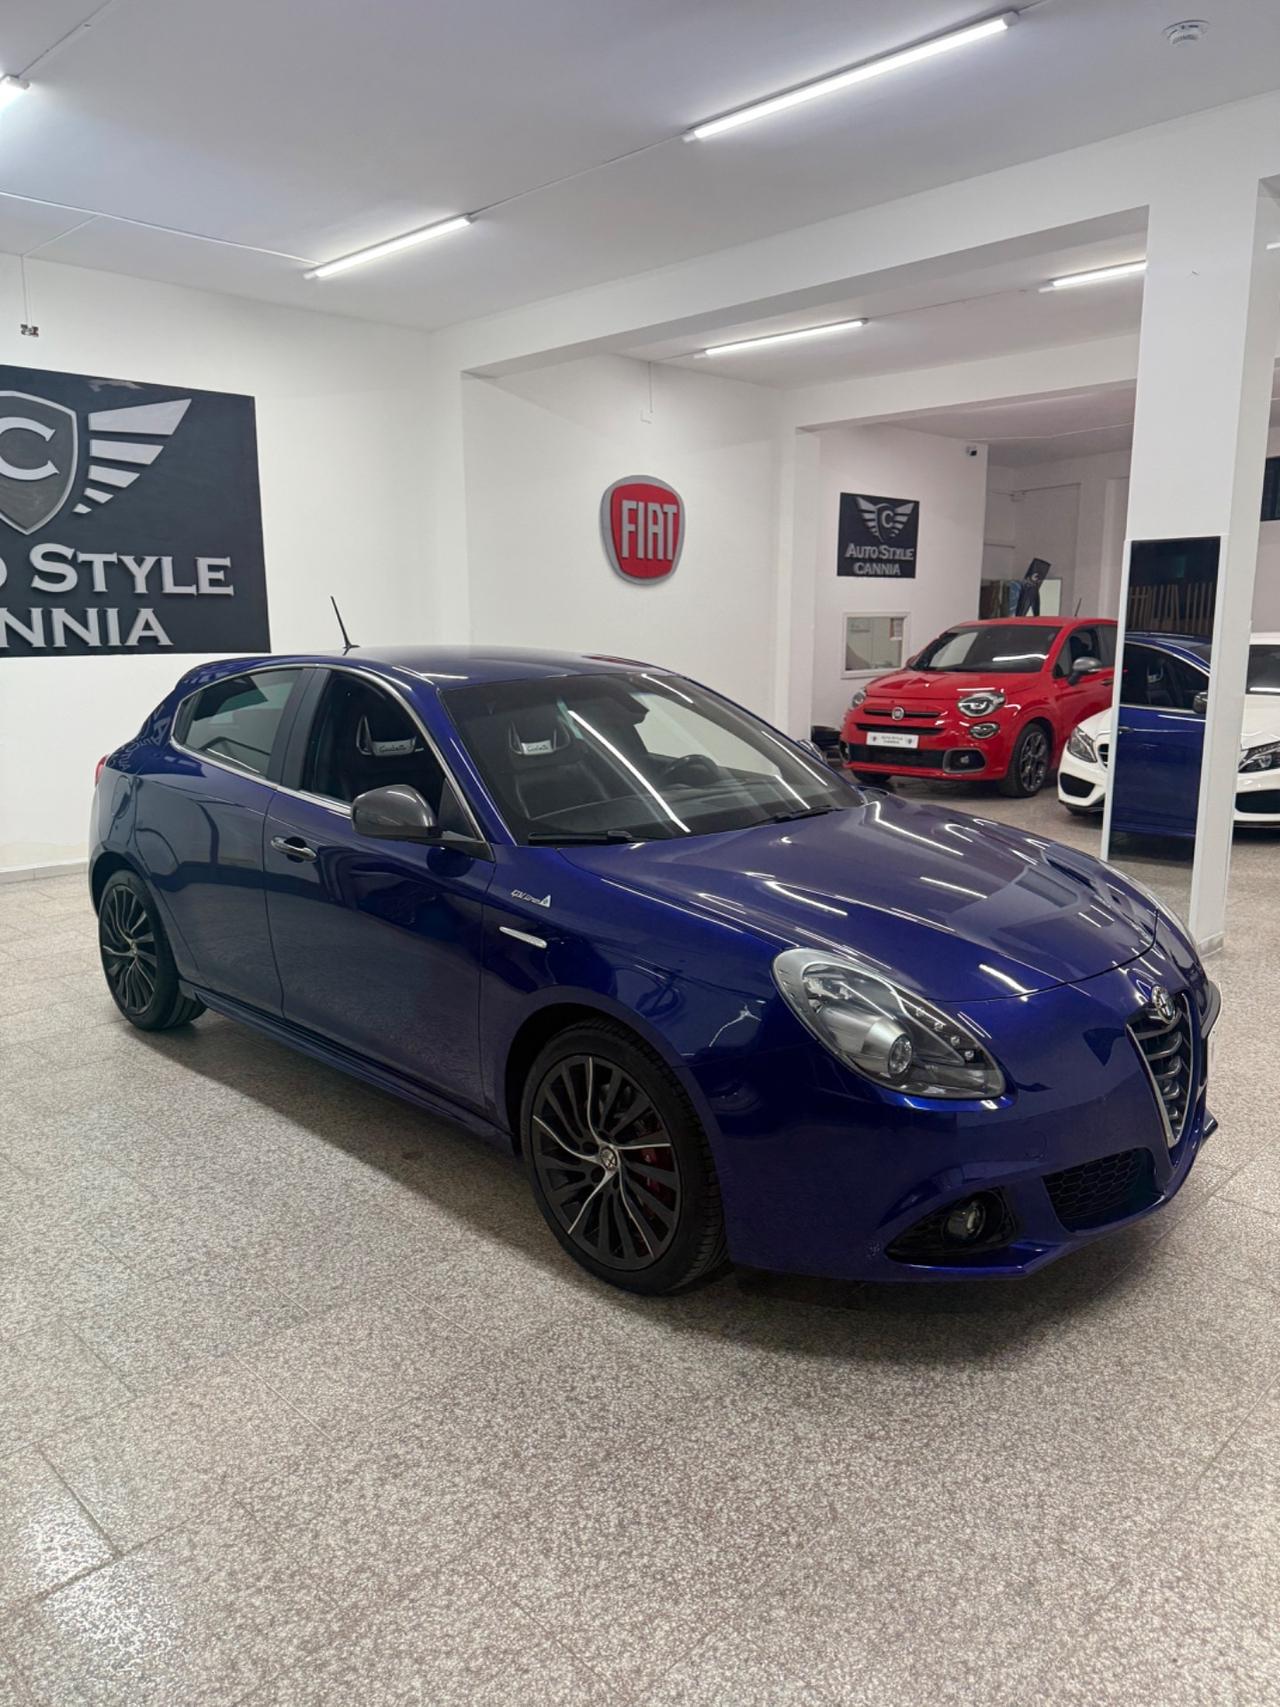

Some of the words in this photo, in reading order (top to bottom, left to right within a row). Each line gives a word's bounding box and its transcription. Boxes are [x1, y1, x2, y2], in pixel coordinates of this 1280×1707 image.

[0, 416, 60, 481] C
[621, 499, 678, 560] FIAT
[881, 510, 895, 529] C
[853, 561, 902, 576] CANNIA
